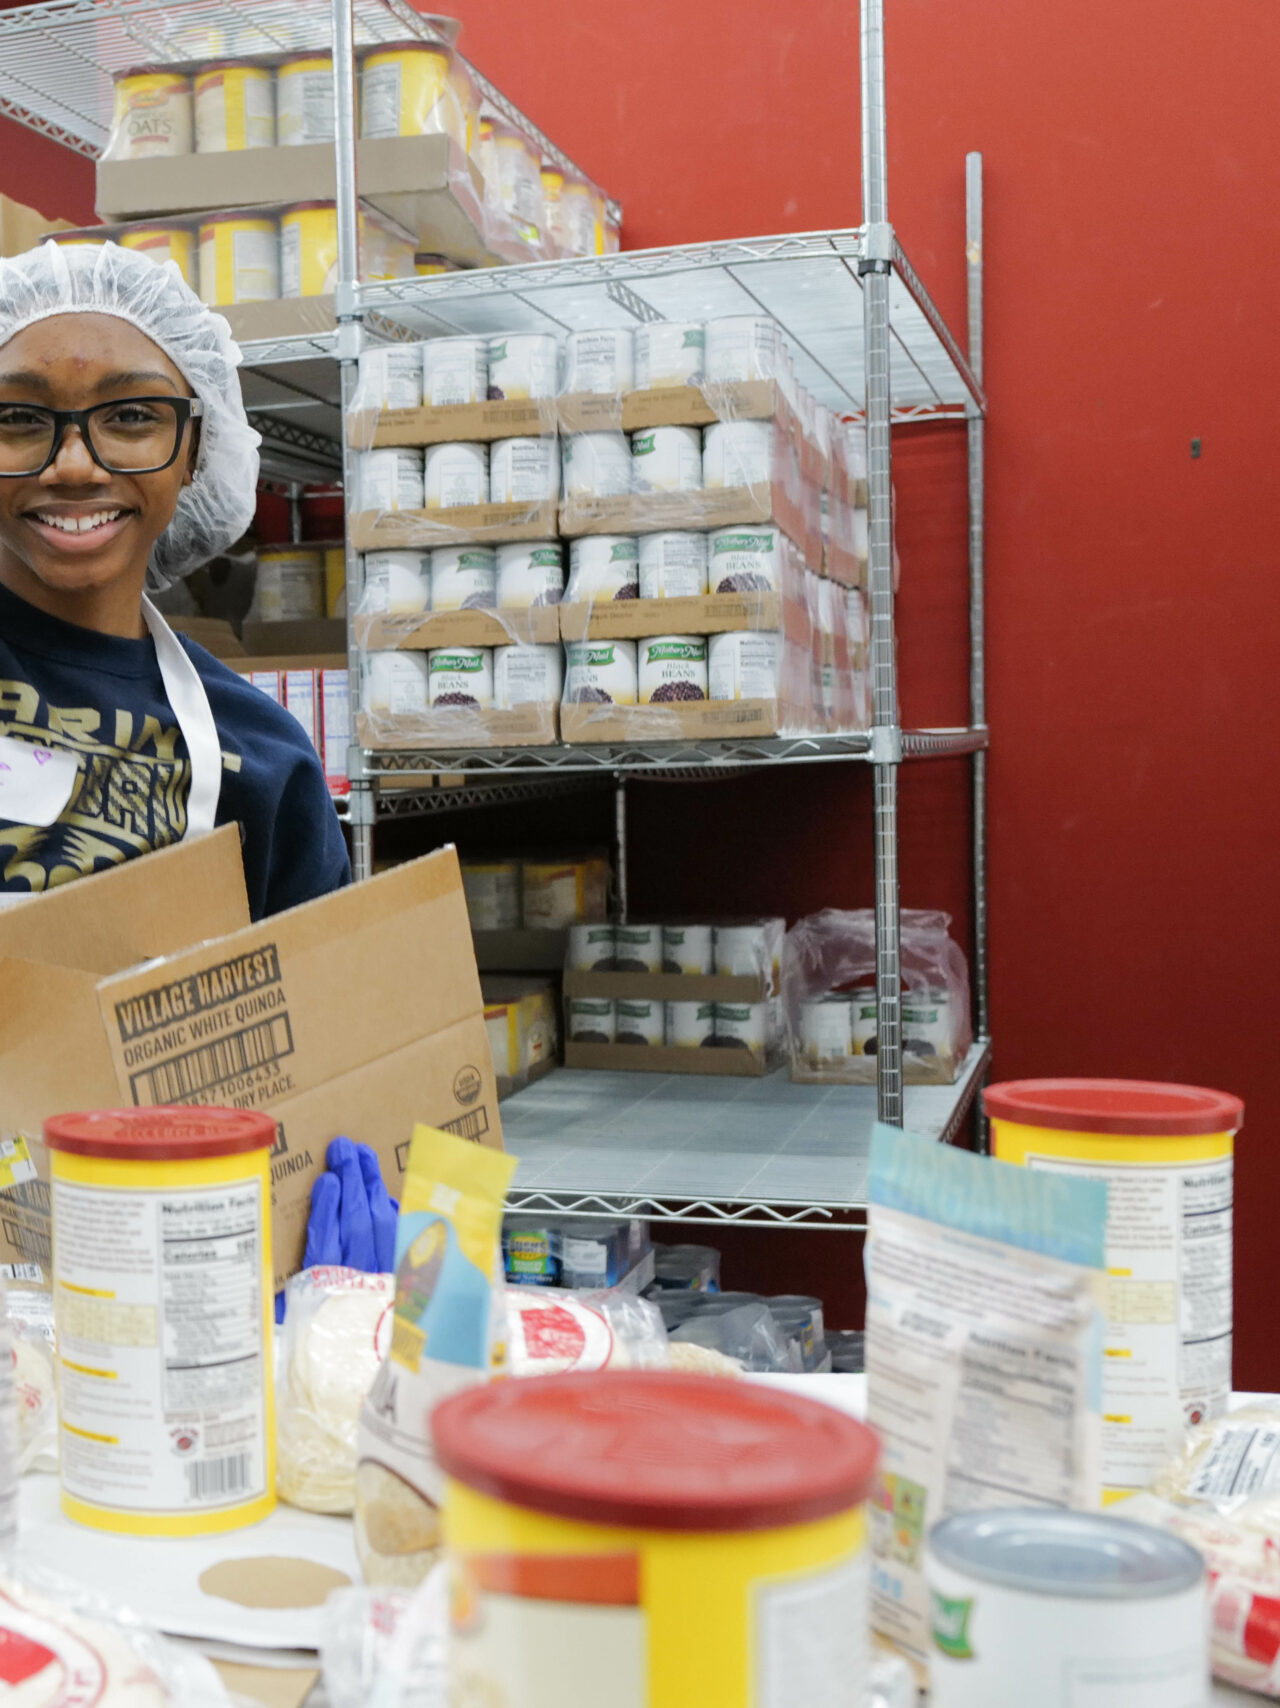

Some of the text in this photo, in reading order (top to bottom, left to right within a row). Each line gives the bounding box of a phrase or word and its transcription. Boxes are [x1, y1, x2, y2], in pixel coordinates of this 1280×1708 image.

[437, 680, 469, 690] BEANS
[662, 669, 696, 679] BEANS
[120, 947, 277, 1039] VILLAGE HARVEST
[123, 987, 287, 1067] ORGANIC WHITE QUINOA
[233, 1074, 297, 1109] DRY PLACE.
[163, 1200, 225, 1214] Nutrition
